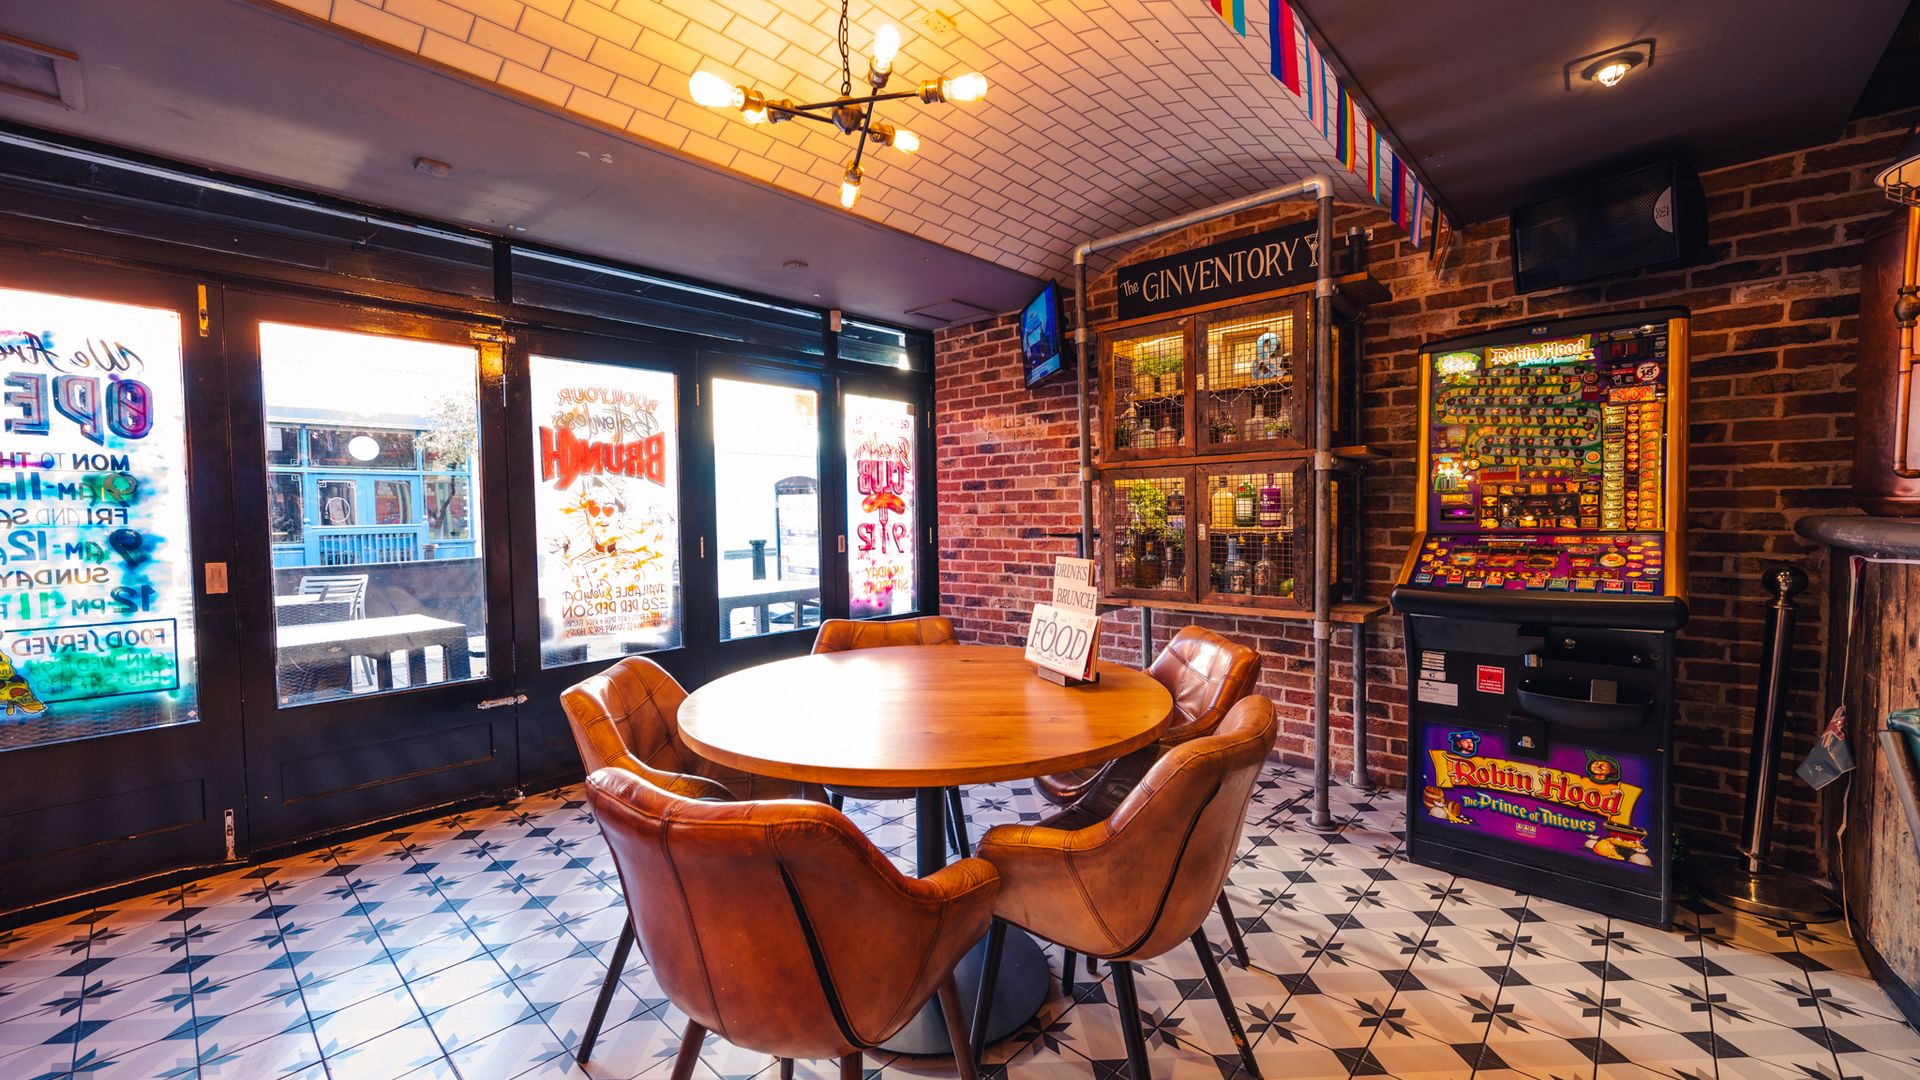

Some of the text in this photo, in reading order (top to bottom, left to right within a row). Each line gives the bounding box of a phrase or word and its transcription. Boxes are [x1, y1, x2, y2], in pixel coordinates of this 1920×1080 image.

[1120, 237, 1300, 302] The GINVENTORY
[1490, 346, 1540, 365] Robin
[1539, 338, 1586, 359] Hood
[1056, 563, 1088, 581] DRINKS
[1056, 588, 1096, 609] BRUNCH
[1029, 618, 1088, 660] FOOD
[1443, 752, 1624, 816] Robin Hood
[1462, 795, 1478, 807] The
[1476, 790, 1528, 819] Prince
[1528, 808, 1541, 822] of
[1538, 805, 1598, 833] Thieves
